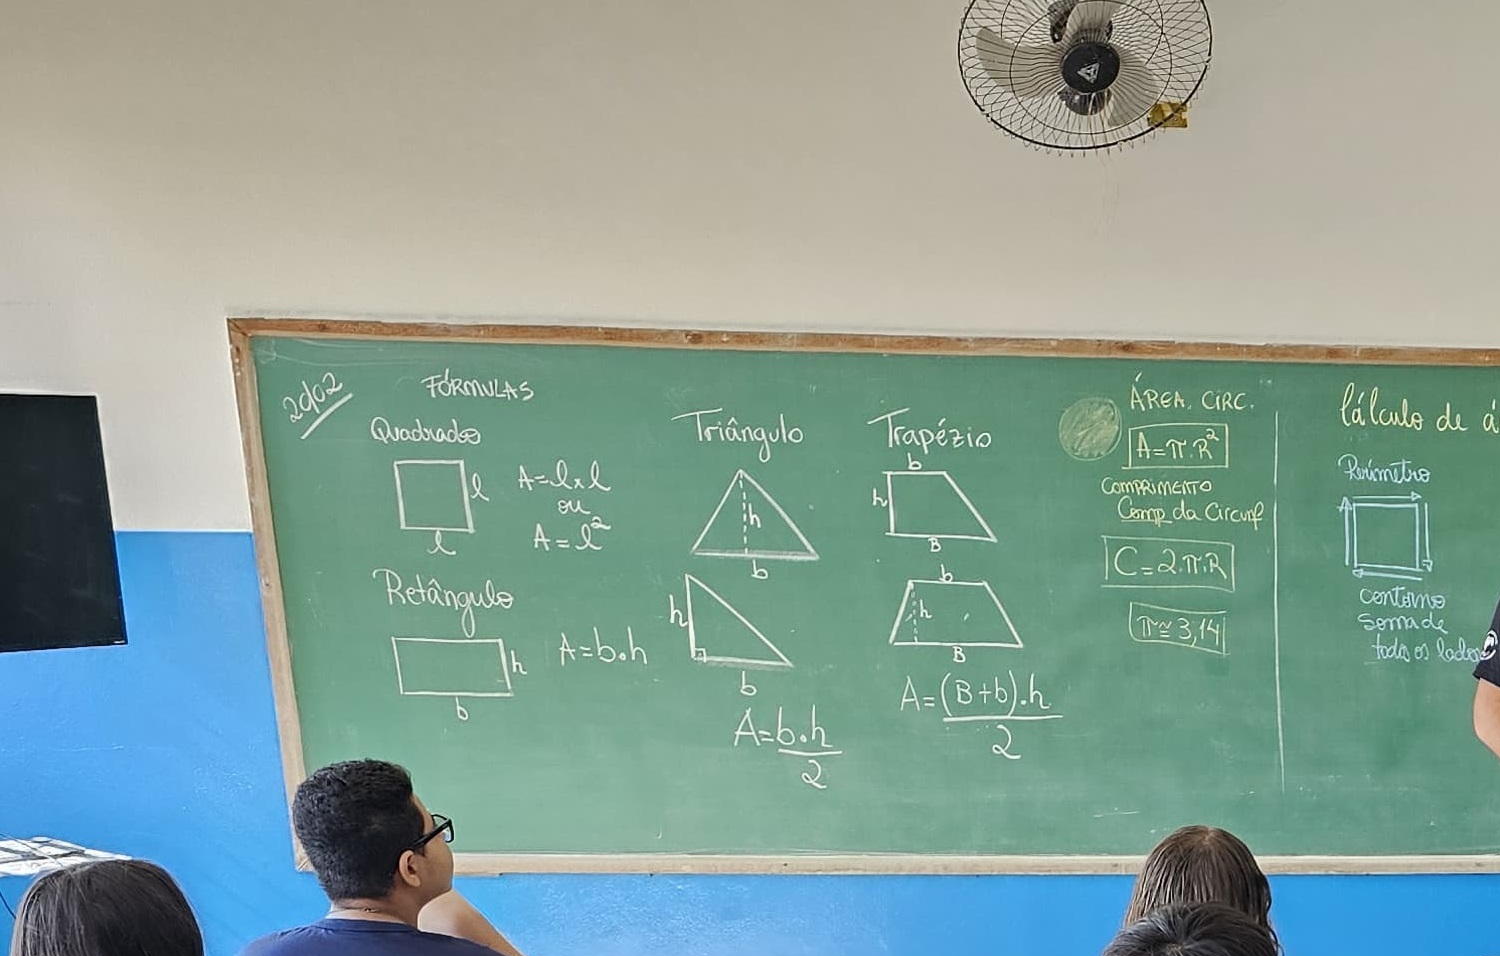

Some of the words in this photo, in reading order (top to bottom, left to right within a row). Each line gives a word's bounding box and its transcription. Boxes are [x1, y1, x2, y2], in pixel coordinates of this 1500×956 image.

[421, 368, 535, 401] FÓRMULAS
[1436, 402, 1468, 432] de
[671, 408, 804, 463] Triângulo
[867, 408, 992, 455] Trapézio
[907, 452, 922, 471] b
[1338, 453, 1432, 484] Perímetro
[872, 487, 889, 508] h
[1101, 477, 1213, 496] COMPRIMENTO
[558, 499, 592, 516] ou
[748, 502, 762, 529] h
[1172, 498, 1203, 521] da
[928, 537, 942, 553] B
[751, 558, 769, 580] b
[938, 563, 954, 583] b
[372, 568, 514, 638] Retângulo
[919, 599, 933, 620] h
[1359, 586, 1446, 610] contorno
[669, 594, 689, 628] h
[1357, 613, 1420, 632] Soma
[1421, 611, 1449, 635] de
[510, 649, 528, 676] h
[952, 645, 967, 664] B
[1414, 642, 1430, 661] os
[739, 670, 758, 696] b
[454, 696, 470, 722] b
[991, 723, 1023, 760] 2
[801, 759, 828, 790] 2
